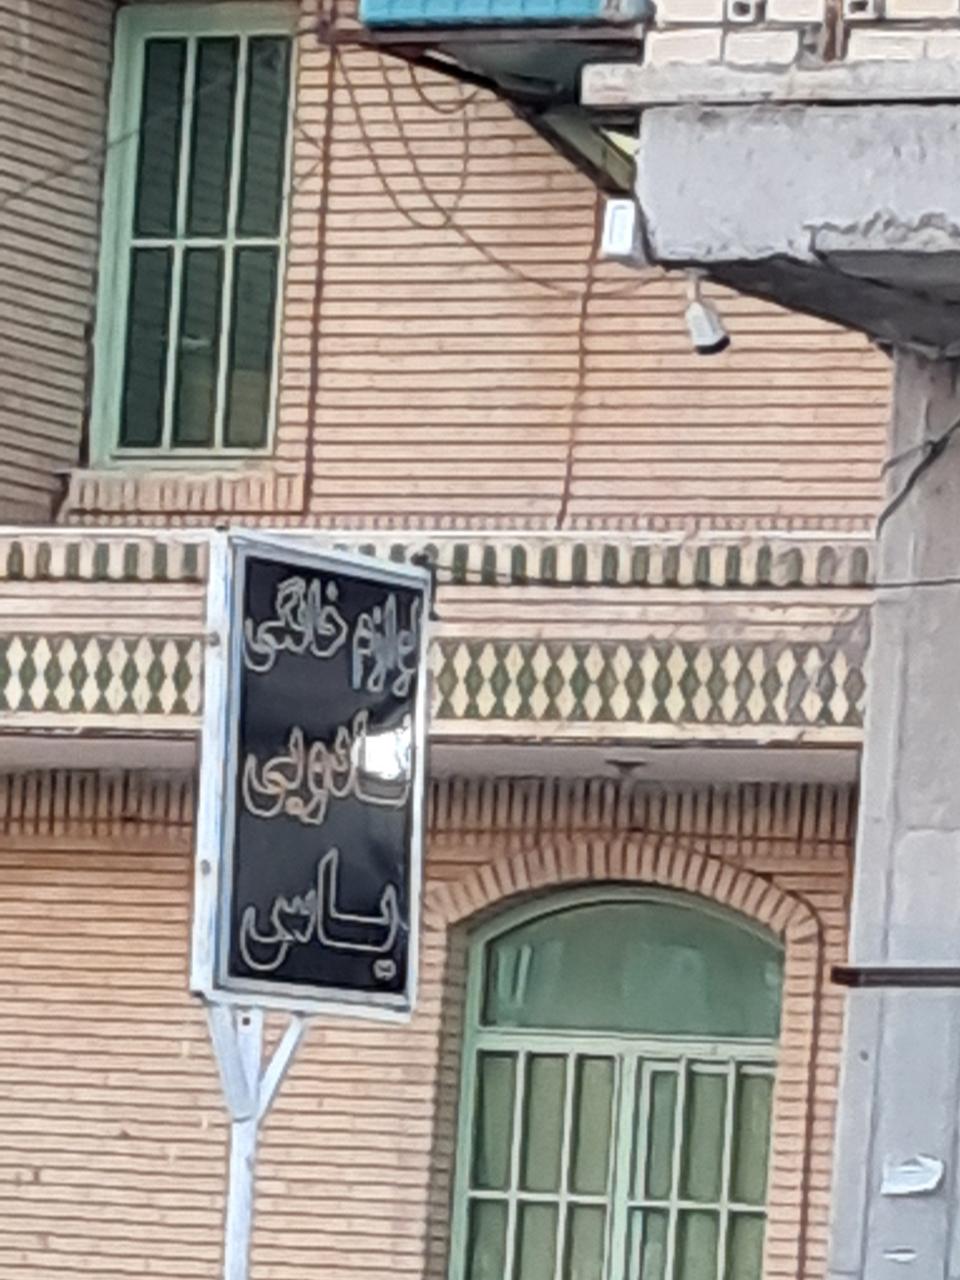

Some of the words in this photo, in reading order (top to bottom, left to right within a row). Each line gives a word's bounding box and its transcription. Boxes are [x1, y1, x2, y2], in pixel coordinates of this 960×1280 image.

[244, 575, 348, 672] خانگی
[352, 593, 419, 696] لوازم
[240, 847, 397, 981] یاس
